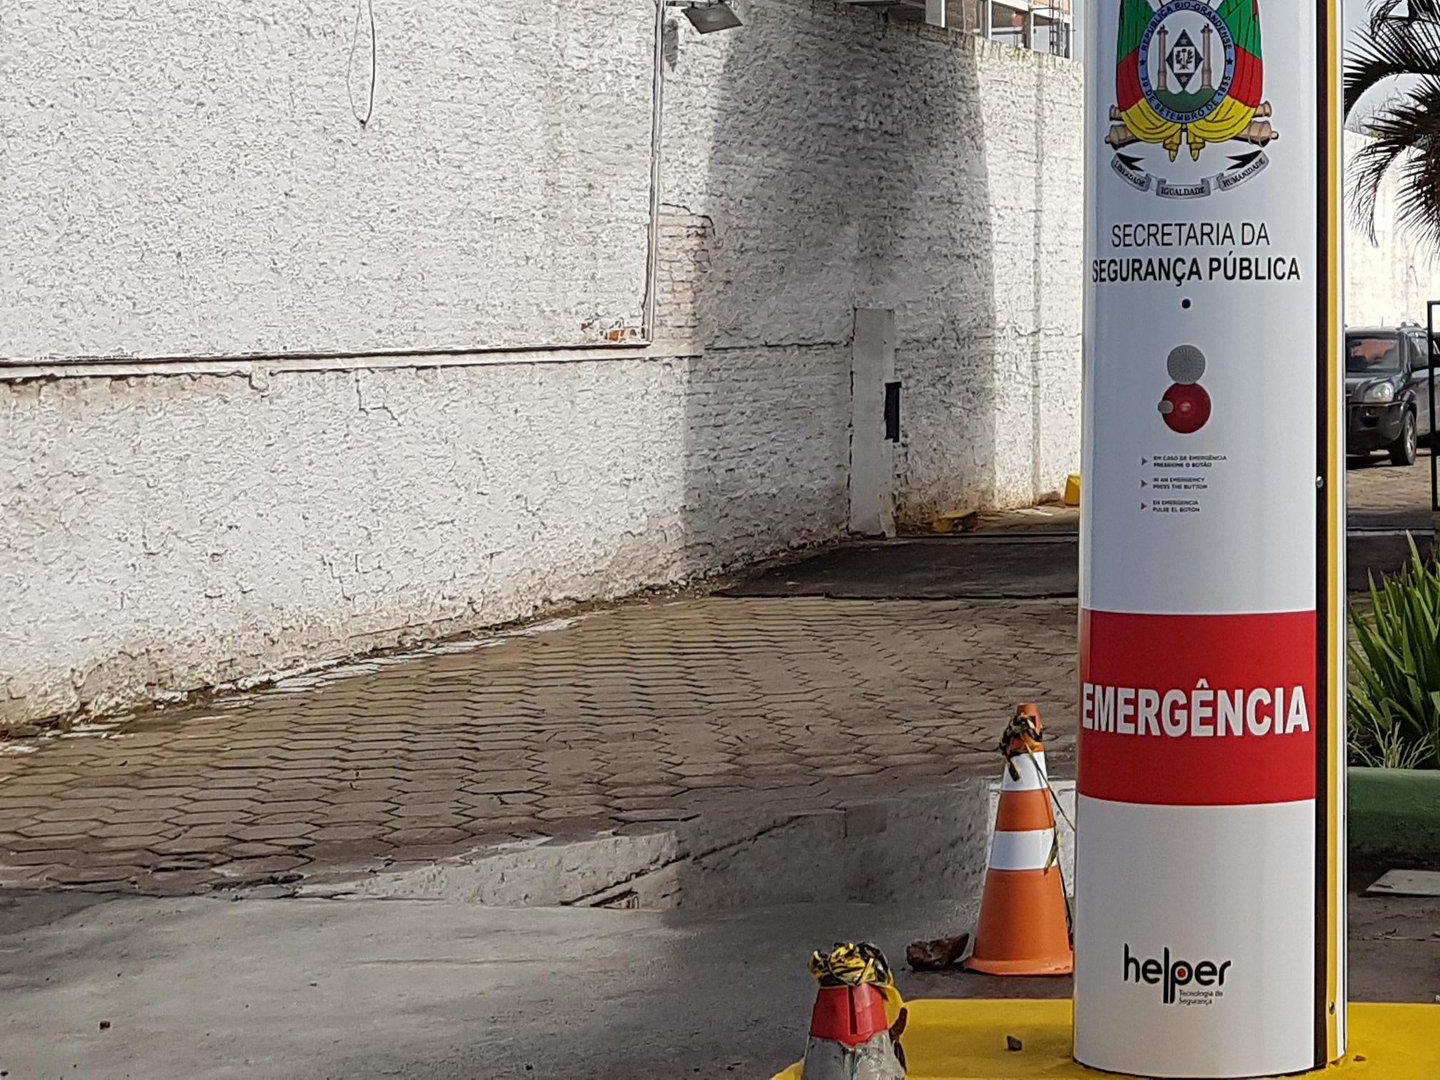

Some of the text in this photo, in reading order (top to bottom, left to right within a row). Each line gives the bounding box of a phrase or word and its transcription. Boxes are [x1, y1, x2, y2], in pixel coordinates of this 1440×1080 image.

[1160, 186, 1206, 197] IGUALDADE
[1111, 222, 1271, 249] SECRETARIA DA
[1092, 251, 1301, 287] SEGURANÇA PÚBLICA
[1083, 679, 1309, 737] EMERGÊNCIA
[1123, 943, 1232, 1004] helper
[1179, 989, 1213, 998] Tecnologia
